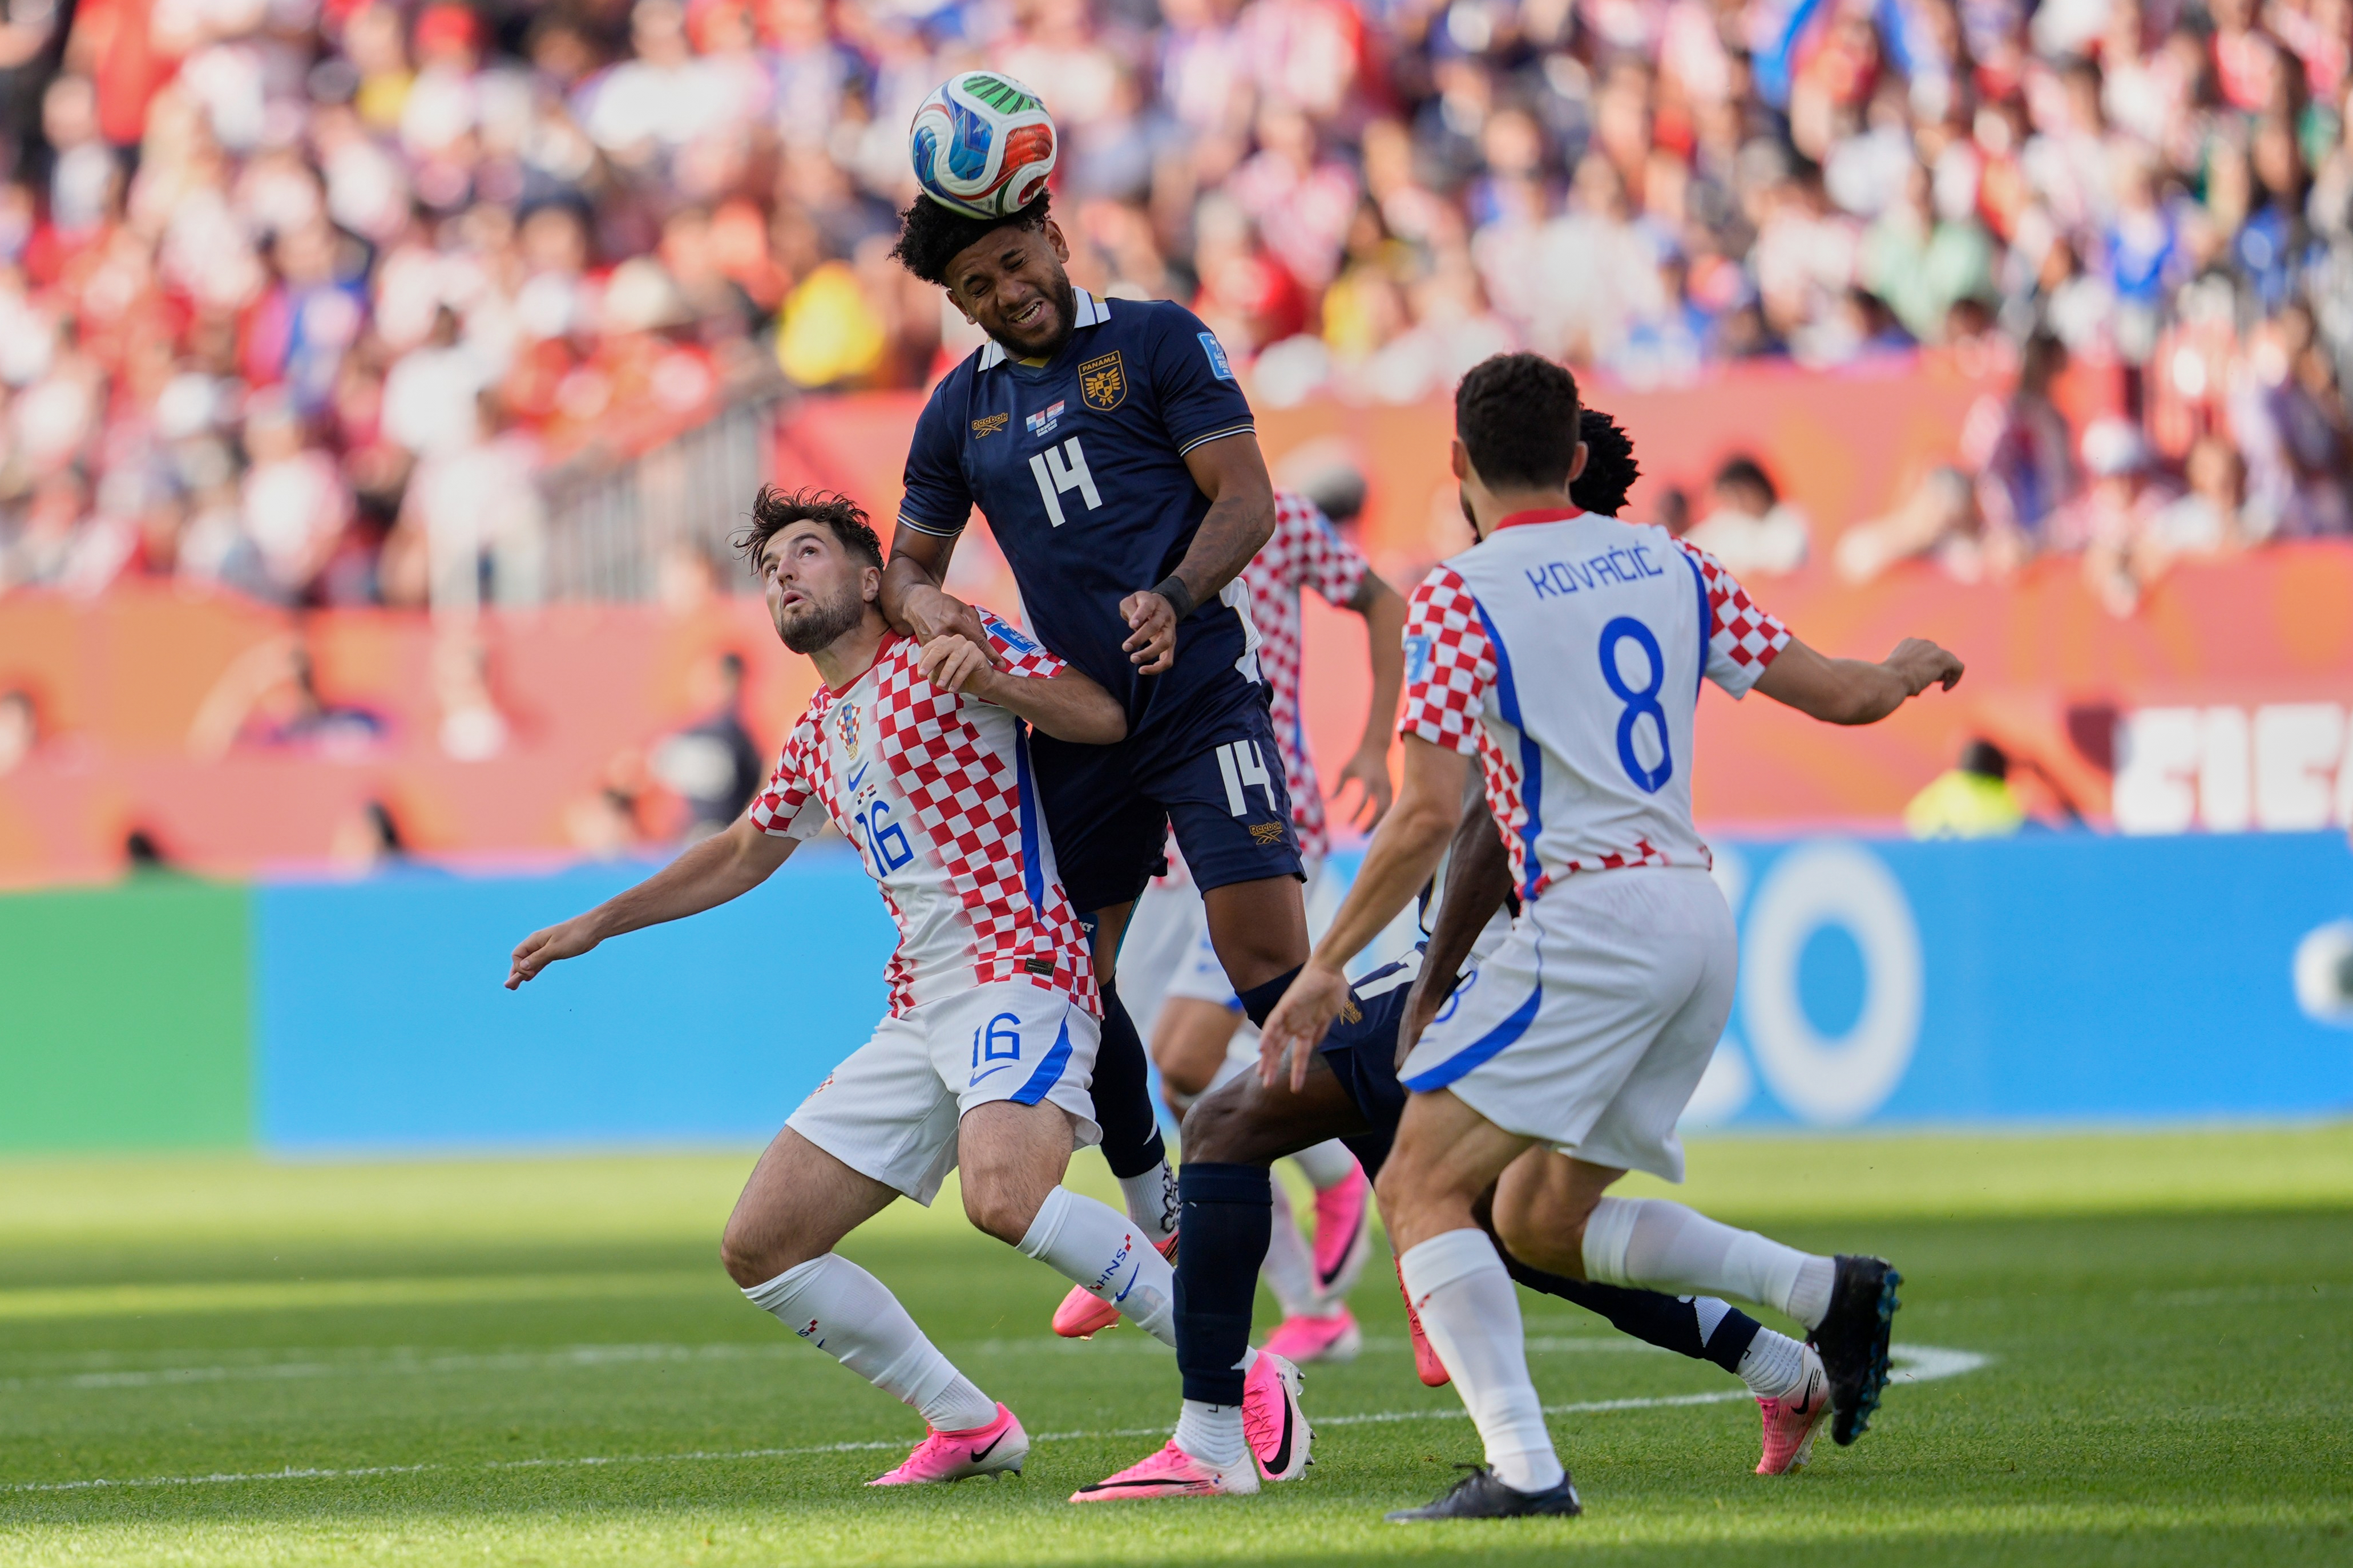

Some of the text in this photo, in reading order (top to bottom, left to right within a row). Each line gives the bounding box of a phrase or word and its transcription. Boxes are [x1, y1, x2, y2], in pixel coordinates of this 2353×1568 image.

[971, 413, 1008, 429] Reebok
[1028, 436, 1103, 528] 14
[1599, 616, 1672, 794] 8
[1215, 739, 1277, 817] 14
[2113, 703, 2353, 833] FIF
[854, 800, 914, 878] 16
[1249, 821, 1282, 835] Reebok
[972, 1012, 1021, 1069] 16
[1096, 1248, 1127, 1286] HNS
